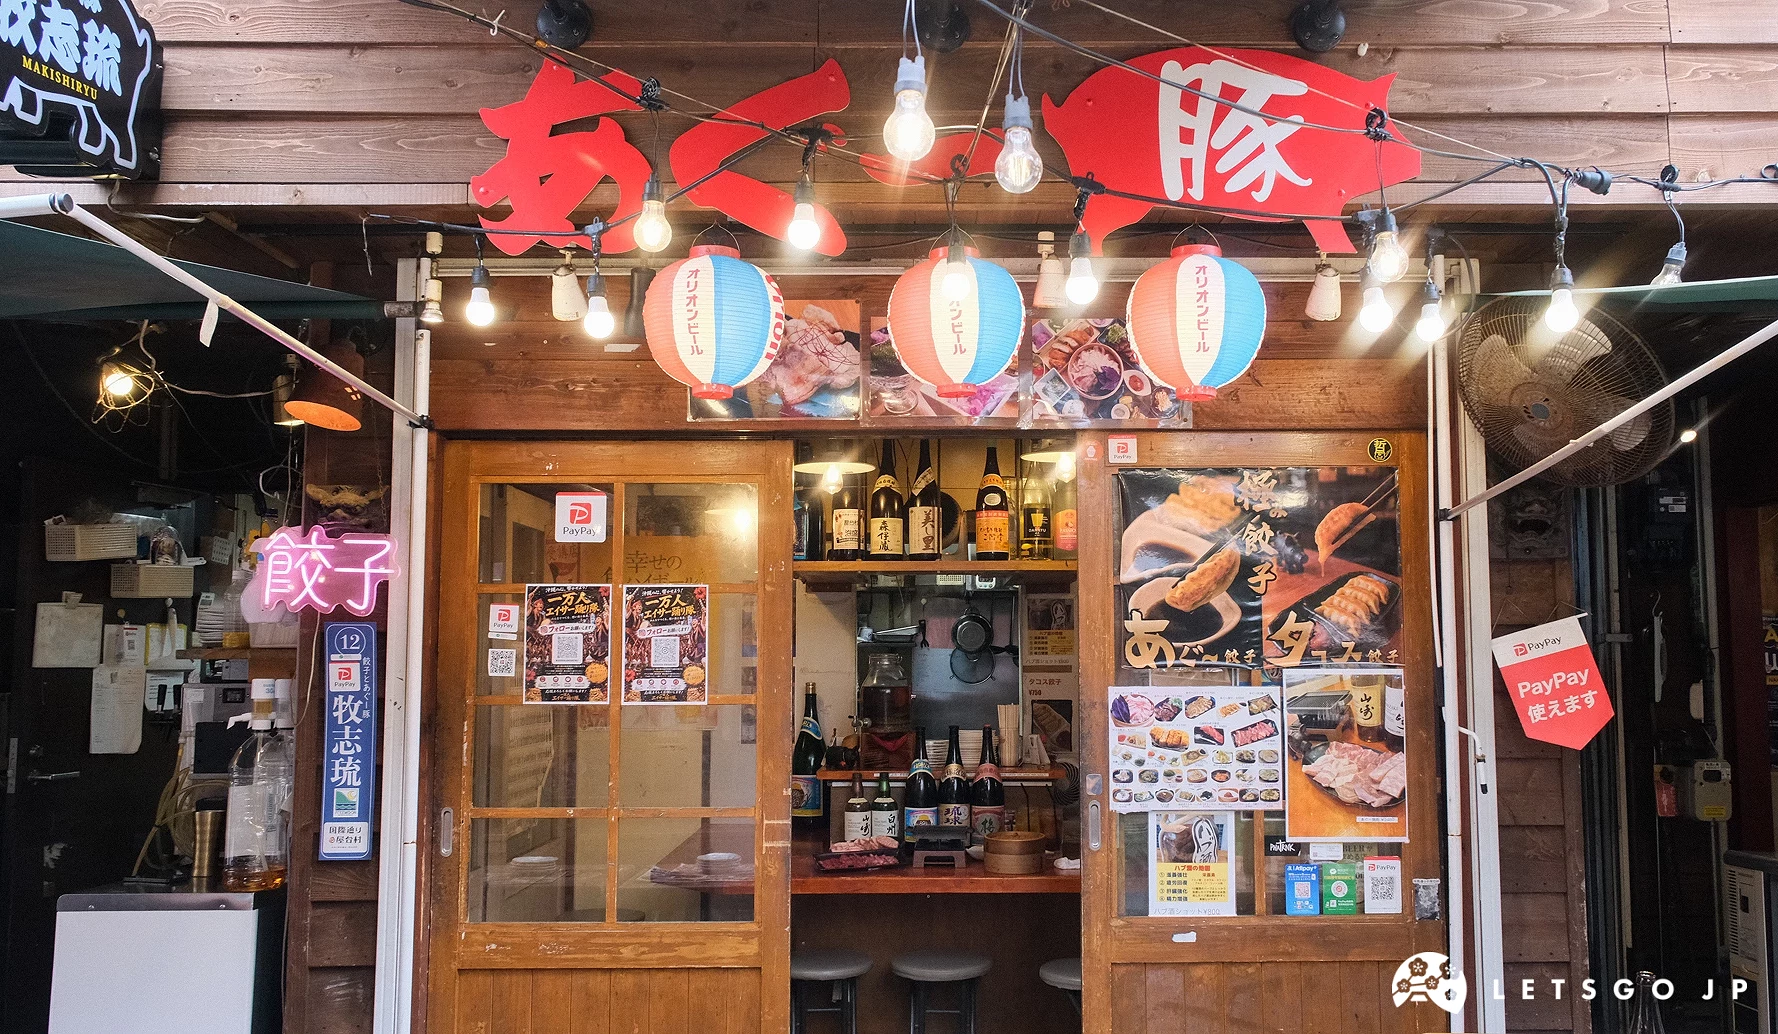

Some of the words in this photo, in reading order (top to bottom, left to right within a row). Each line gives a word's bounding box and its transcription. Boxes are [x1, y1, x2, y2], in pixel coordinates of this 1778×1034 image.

[22, 54, 99, 100] MAKISHIRYU
[686, 268, 703, 356] オリオンビール
[1195, 265, 1210, 353] オリオンビール
[563, 526, 598, 536] PayPay
[265, 531, 395, 610] 餃子
[625, 550, 682, 573] 幸せの
[547, 591, 592, 606] 一万人
[645, 594, 688, 609] 一万人
[340, 634, 360, 650] 12
[1263, 610, 1399, 668] タコス餃子
[1527, 636, 1562, 651] PayPay
[1517, 668, 1590, 699] PayPay
[1528, 689, 1598, 723] 使えます
[330, 694, 363, 787] 牧志琉
